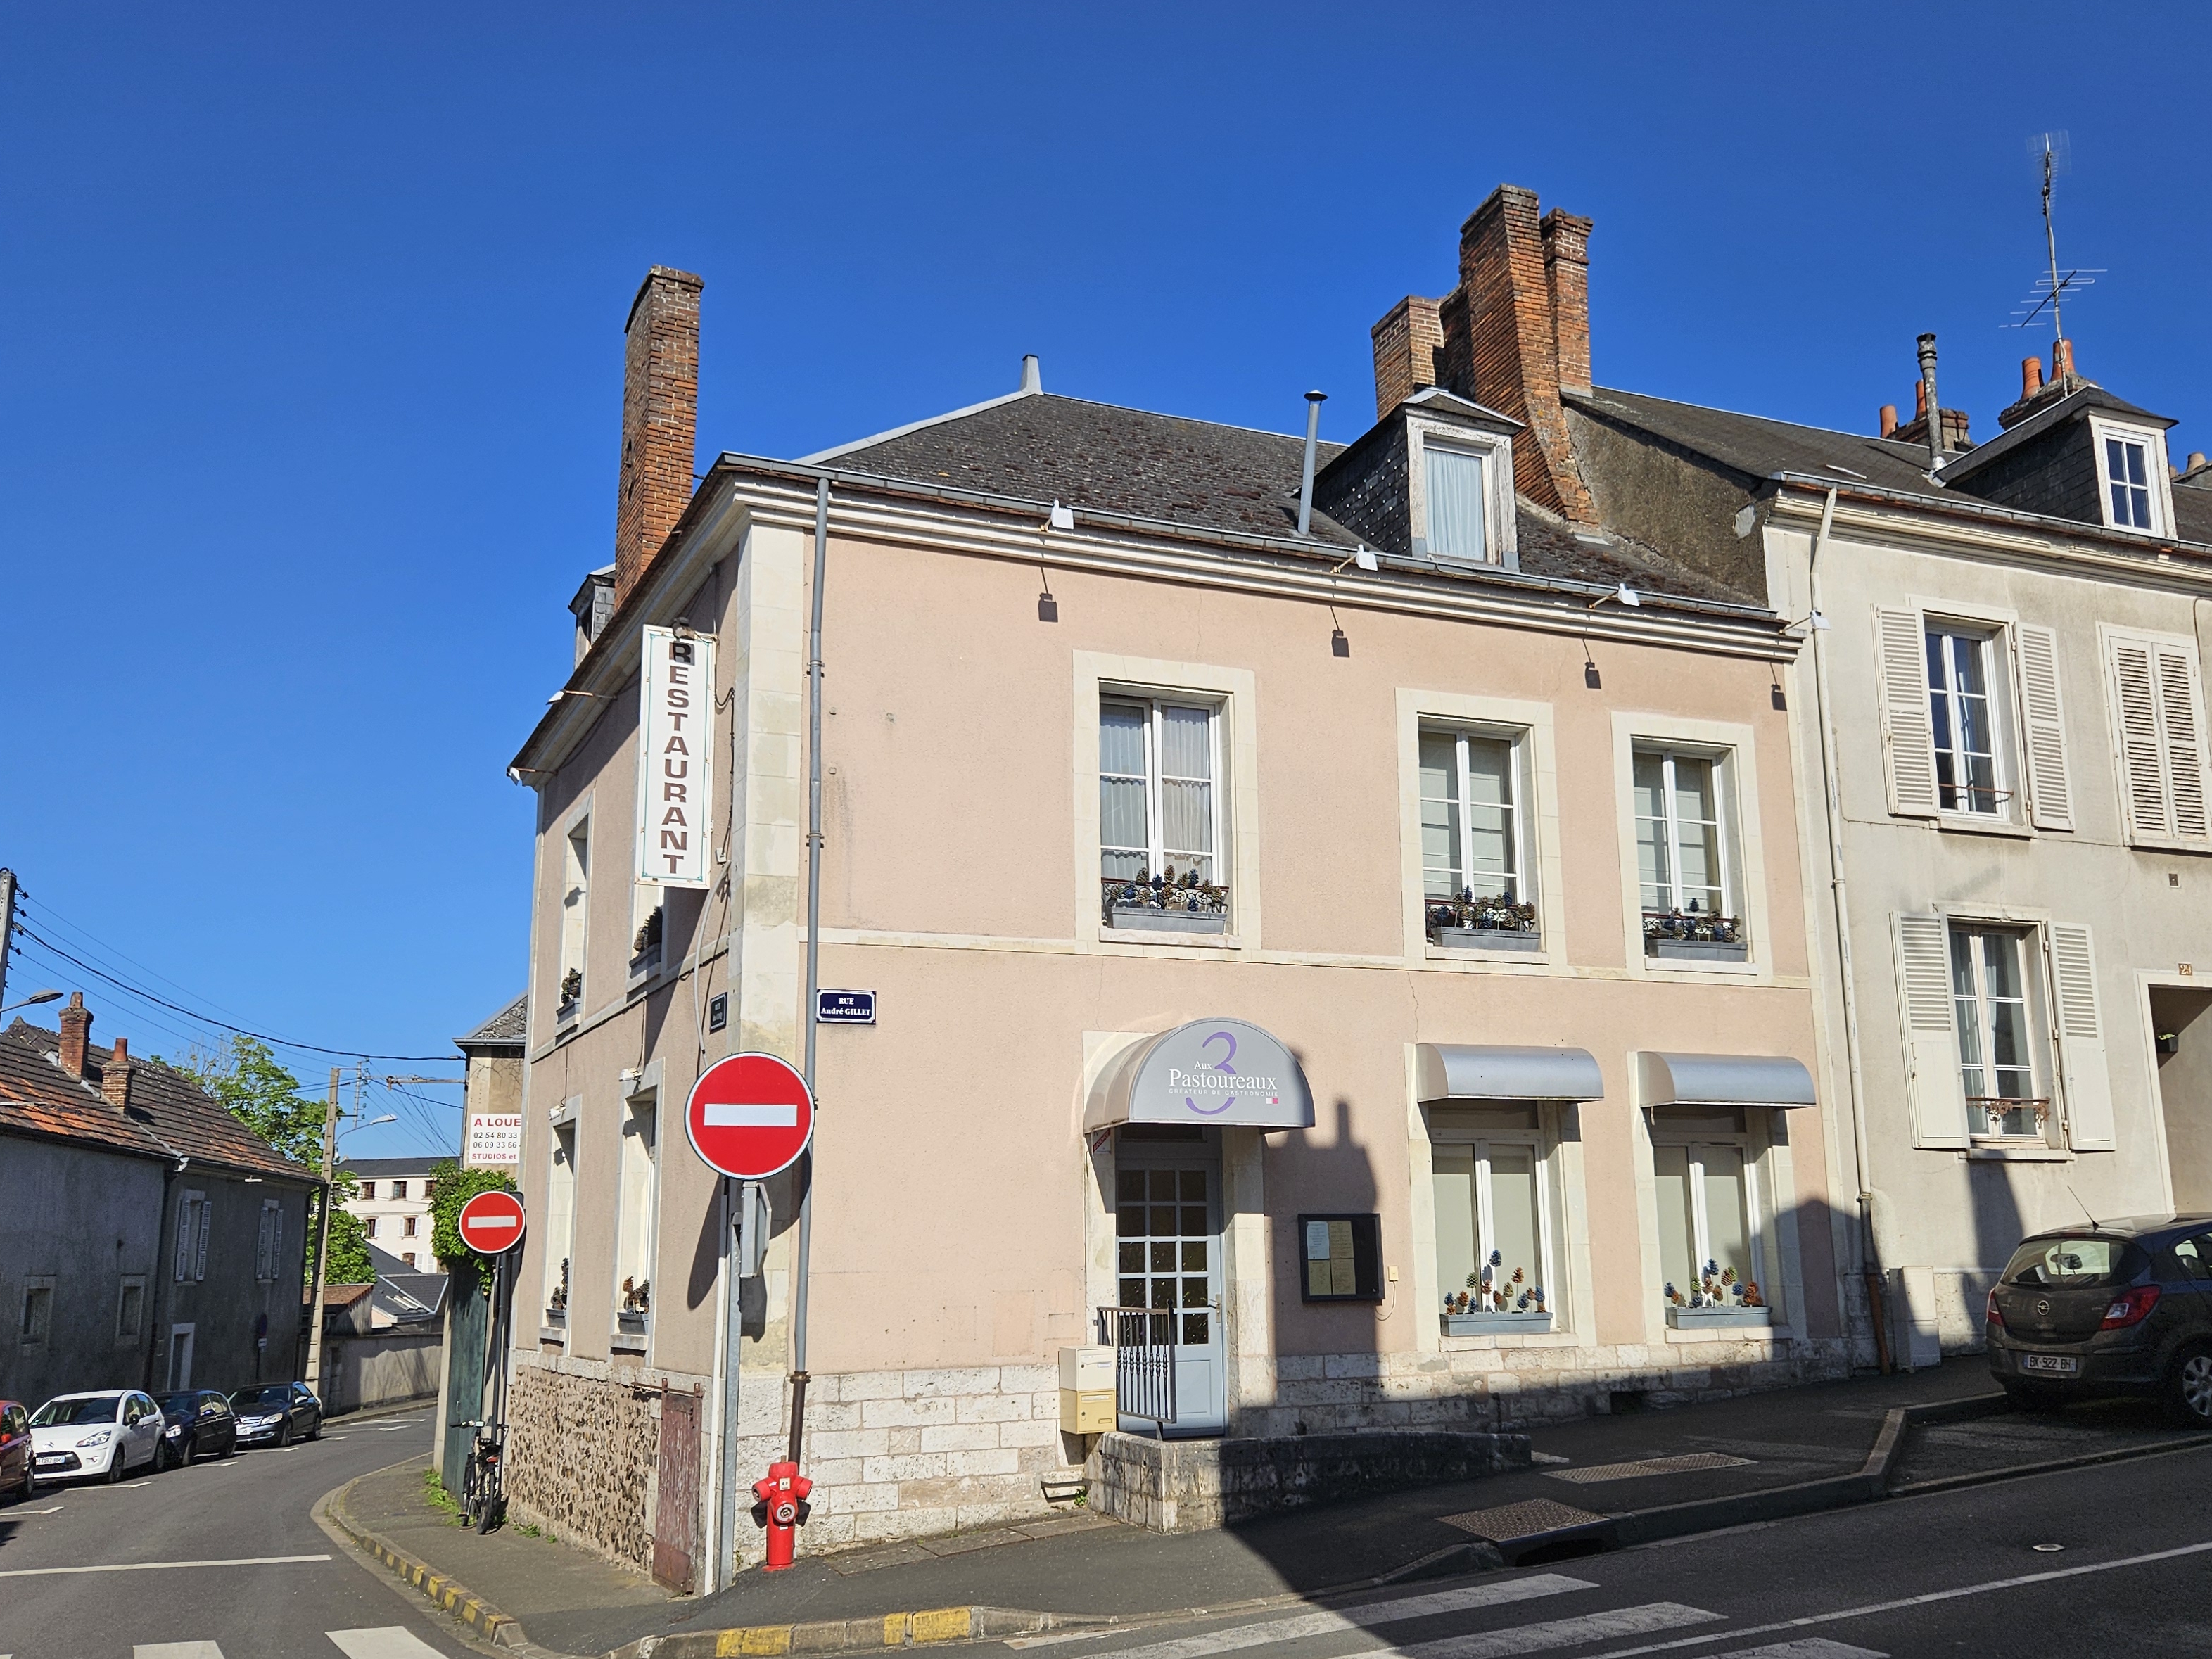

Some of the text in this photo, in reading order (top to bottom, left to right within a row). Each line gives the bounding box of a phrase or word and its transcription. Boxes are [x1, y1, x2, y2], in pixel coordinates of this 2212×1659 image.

[660, 642, 692, 875] RESTAURANT
[1194, 1060, 1212, 1070] Aux
[1169, 1068, 1277, 1090] Pastoureaux
[474, 1118, 521, 1126] A LOUE
